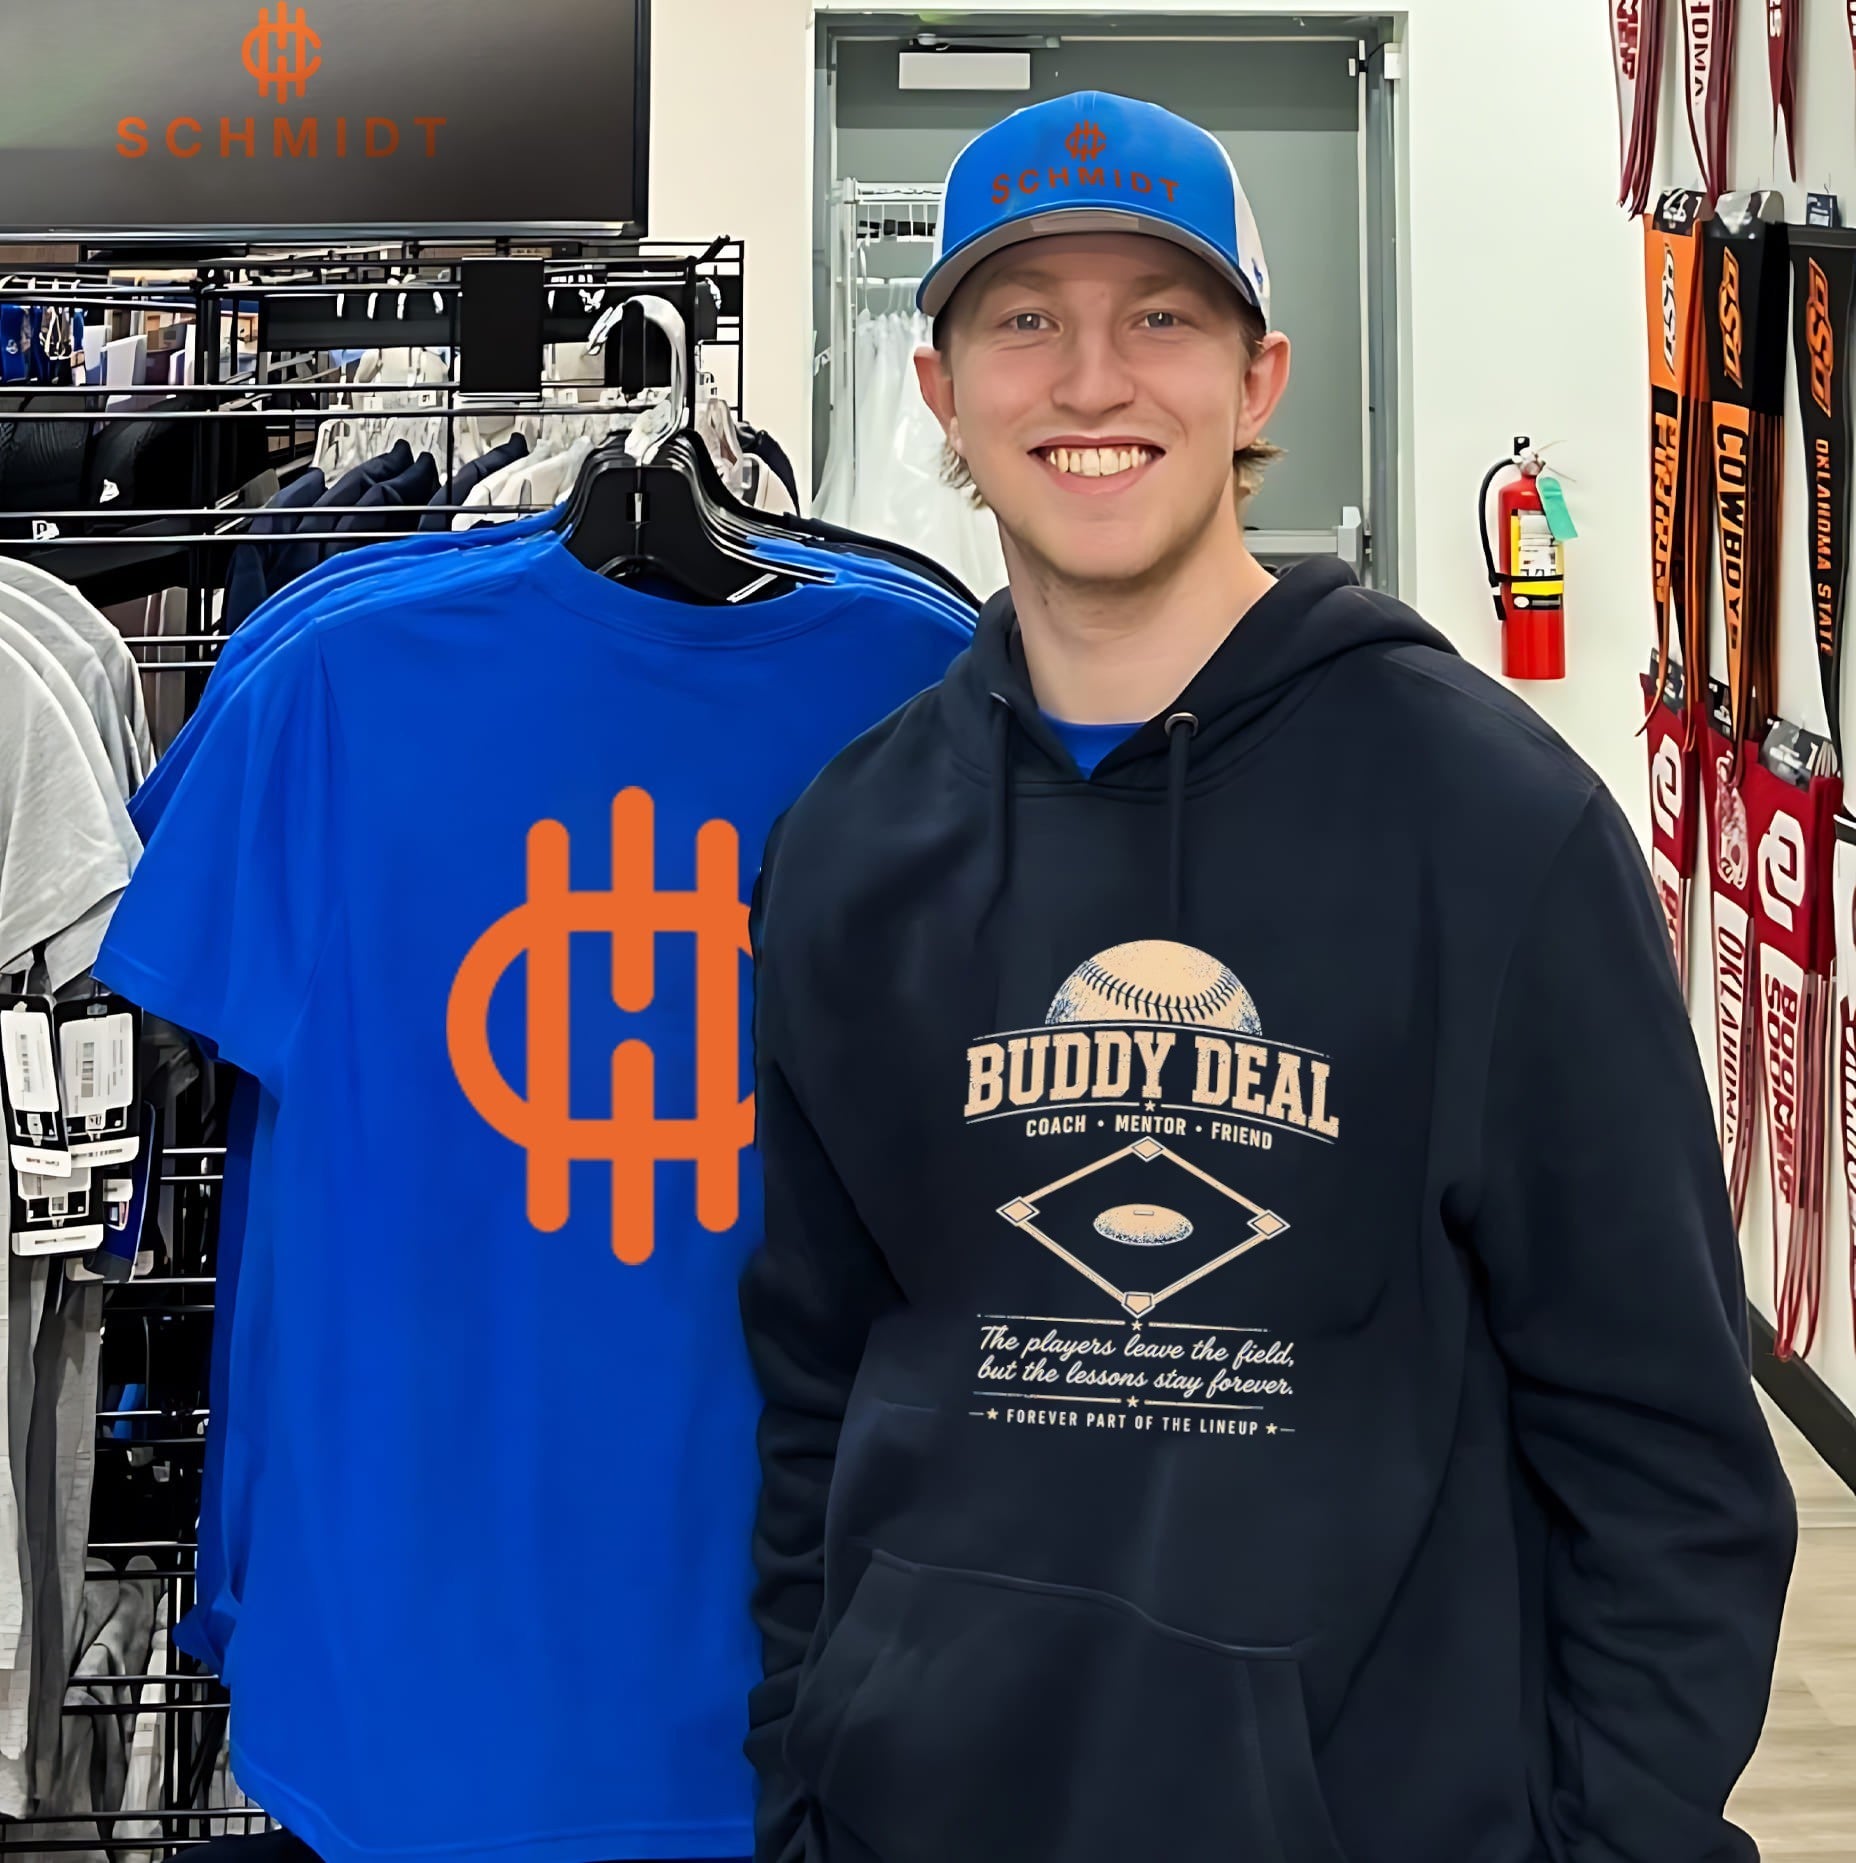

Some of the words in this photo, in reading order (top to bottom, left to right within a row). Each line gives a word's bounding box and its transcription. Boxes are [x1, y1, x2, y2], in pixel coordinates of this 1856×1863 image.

[116, 117, 447, 159] SCHMIDT
[991, 166, 1179, 204] SCHMIDT
[964, 1030, 1176, 1117] BUDDY
[1192, 1035, 1340, 1138] DEAL
[1026, 1115, 1086, 1137] COACH
[1115, 1114, 1186, 1136] MENTOR
[1211, 1121, 1272, 1150] FRIEND
[980, 1325, 1019, 1351] The
[1021, 1329, 1115, 1361] players
[1124, 1333, 1185, 1358] leave
[1190, 1336, 1229, 1361] the
[1232, 1341, 1295, 1370] field,
[977, 1354, 1017, 1379] but
[1021, 1358, 1059, 1382] the
[1066, 1360, 1148, 1387] lessons
[1153, 1368, 1203, 1398] stay
[1205, 1368, 1294, 1399] forever.
[1006, 1408, 1078, 1426] FOREVER
[1086, 1412, 1127, 1429] PART
[1134, 1416, 1154, 1430] OF
[1162, 1417, 1192, 1432] THE
[1199, 1418, 1259, 1436] LINEUP
